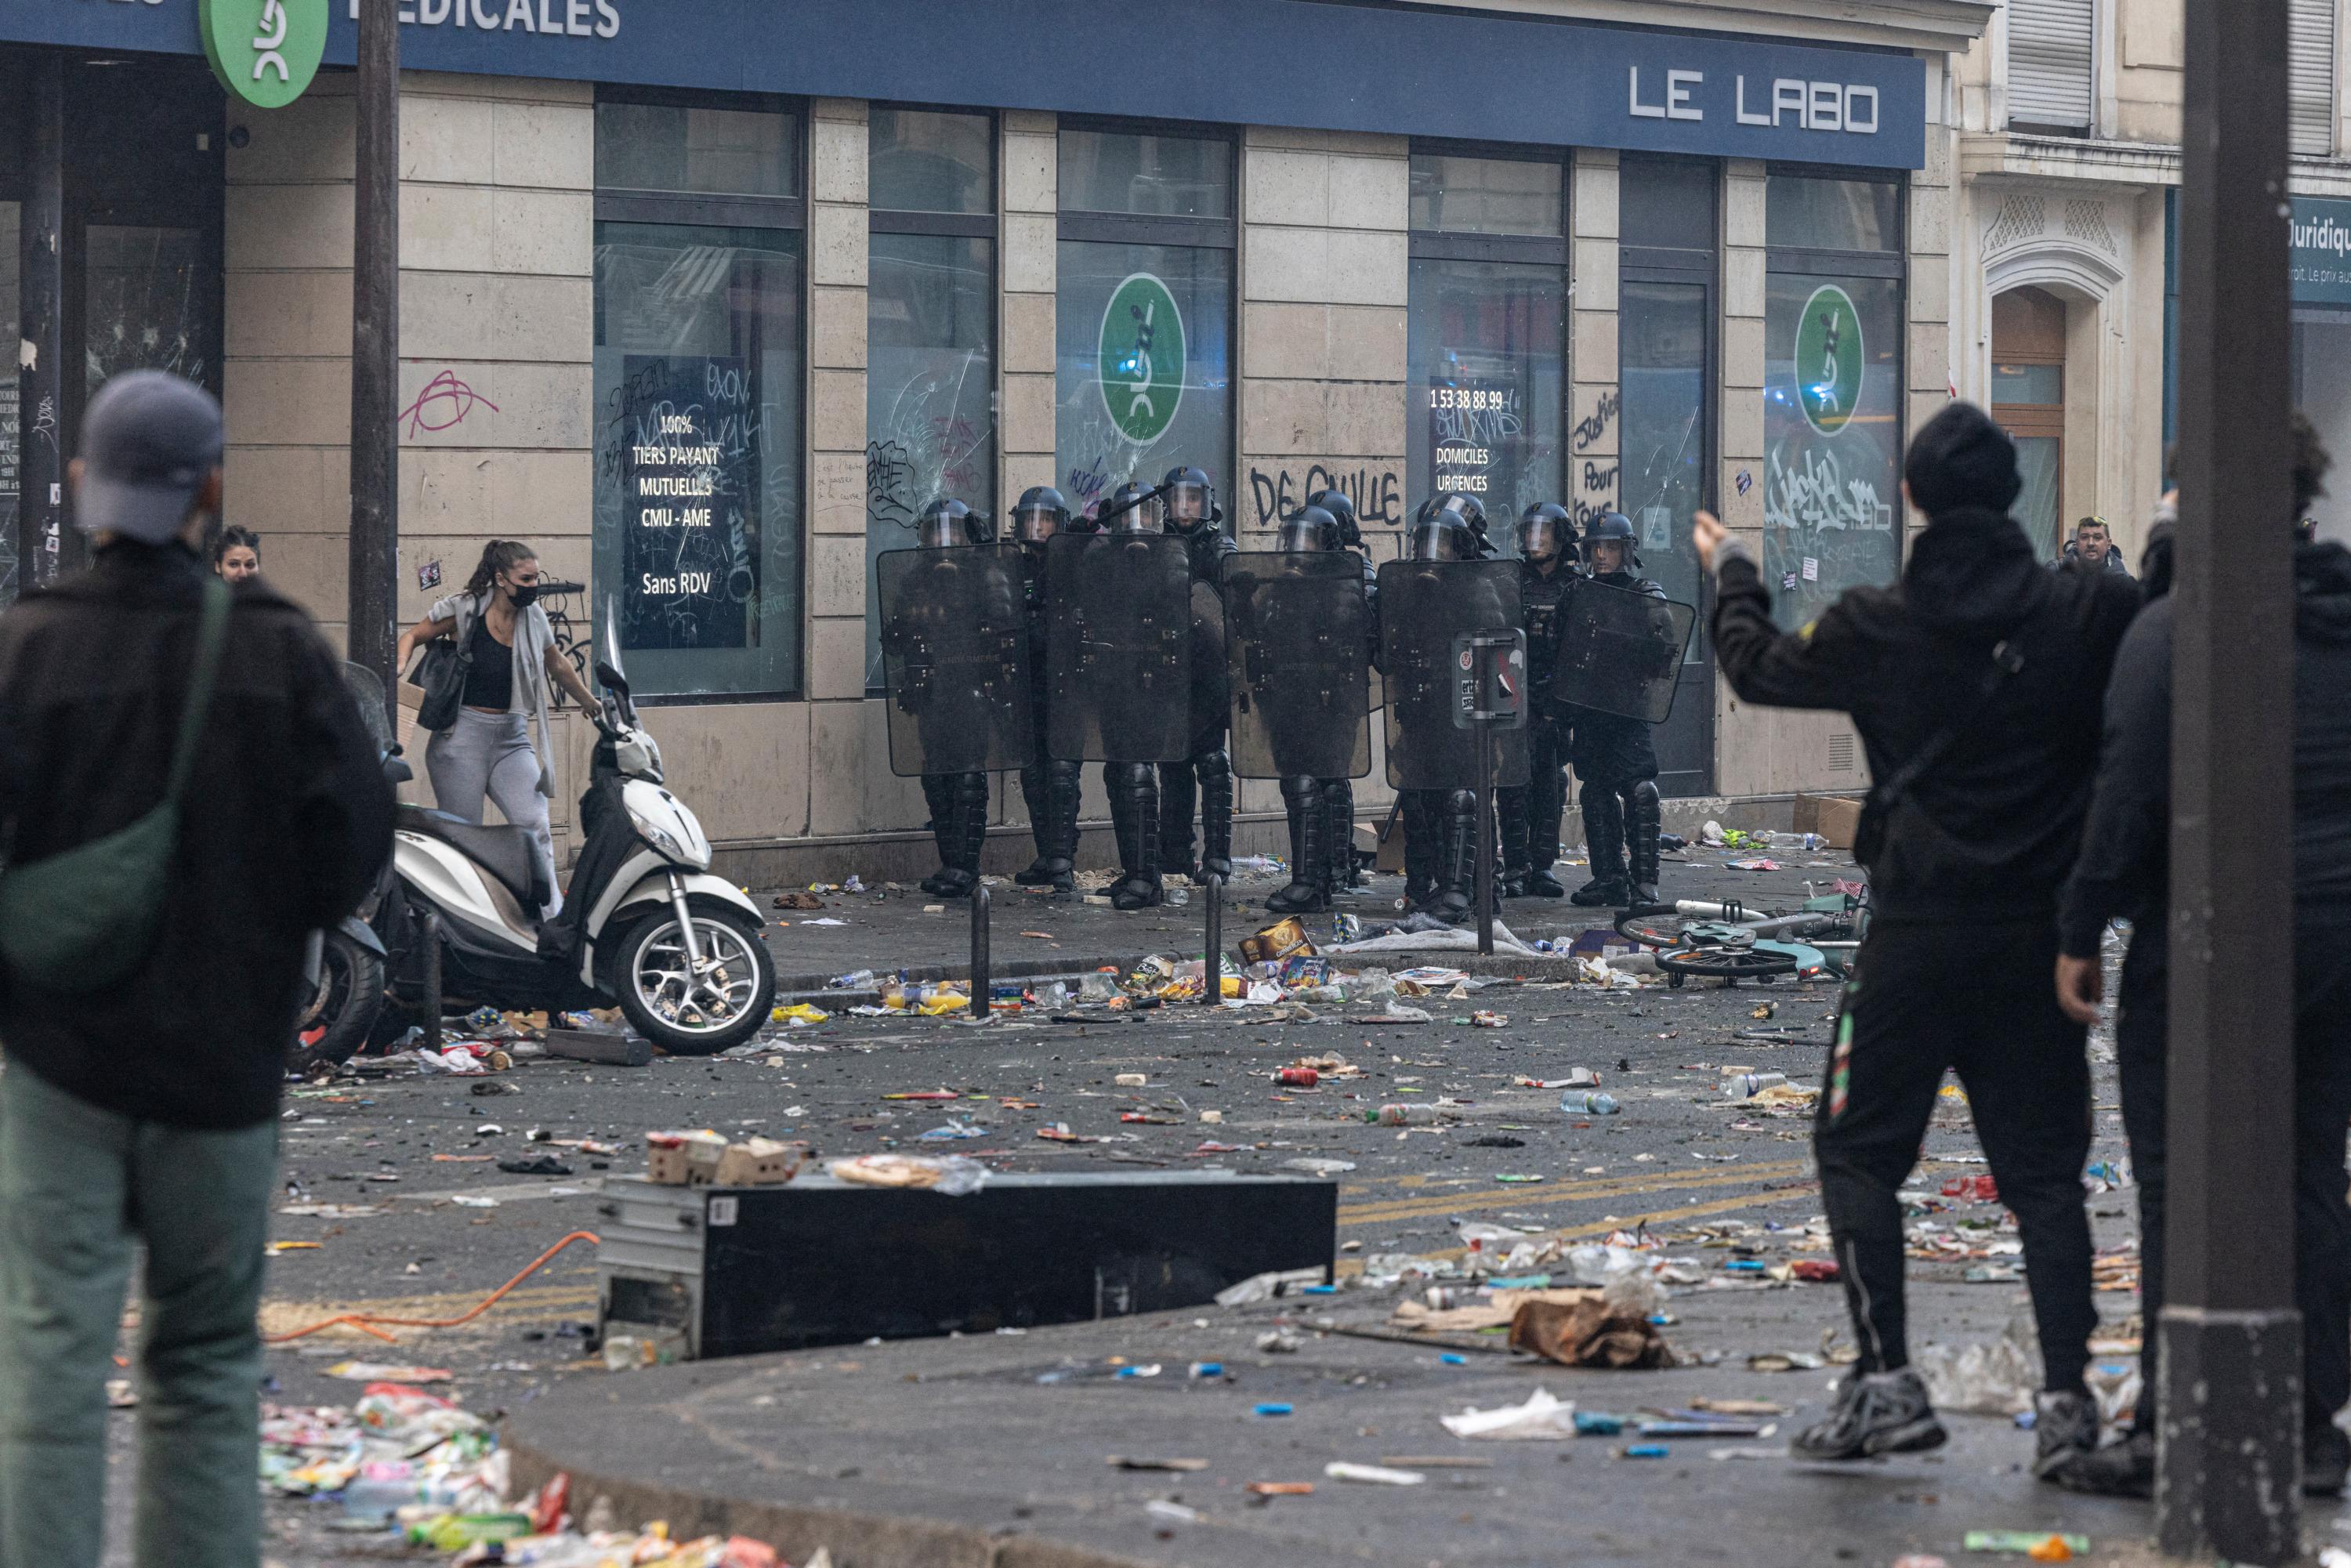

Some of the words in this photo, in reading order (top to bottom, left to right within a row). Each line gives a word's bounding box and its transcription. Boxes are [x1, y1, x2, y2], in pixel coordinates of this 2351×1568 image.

[1630, 67, 1703, 121] LE
[1737, 75, 1878, 134] LABO
[2309, 266, 2319, 282] Le
[2320, 266, 2336, 286] prix
[1430, 389, 1437, 408] 1
[1440, 390, 1454, 408] 53
[1457, 390, 1470, 409] 38
[1473, 391, 1486, 409] 88
[1489, 391, 1502, 410] 99
[660, 416, 693, 434] 100%
[632, 447, 666, 465] TIERS
[670, 447, 719, 465] PAYANT
[1436, 447, 1488, 465] DOMICILES
[1438, 474, 1487, 491] URGENCES
[1585, 461, 1617, 491] Pour
[640, 477, 712, 496] MUTUELLES
[642, 509, 672, 527] CMU
[683, 509, 711, 527] AME
[643, 573, 676, 595] Sans
[680, 573, 711, 594] RDV
